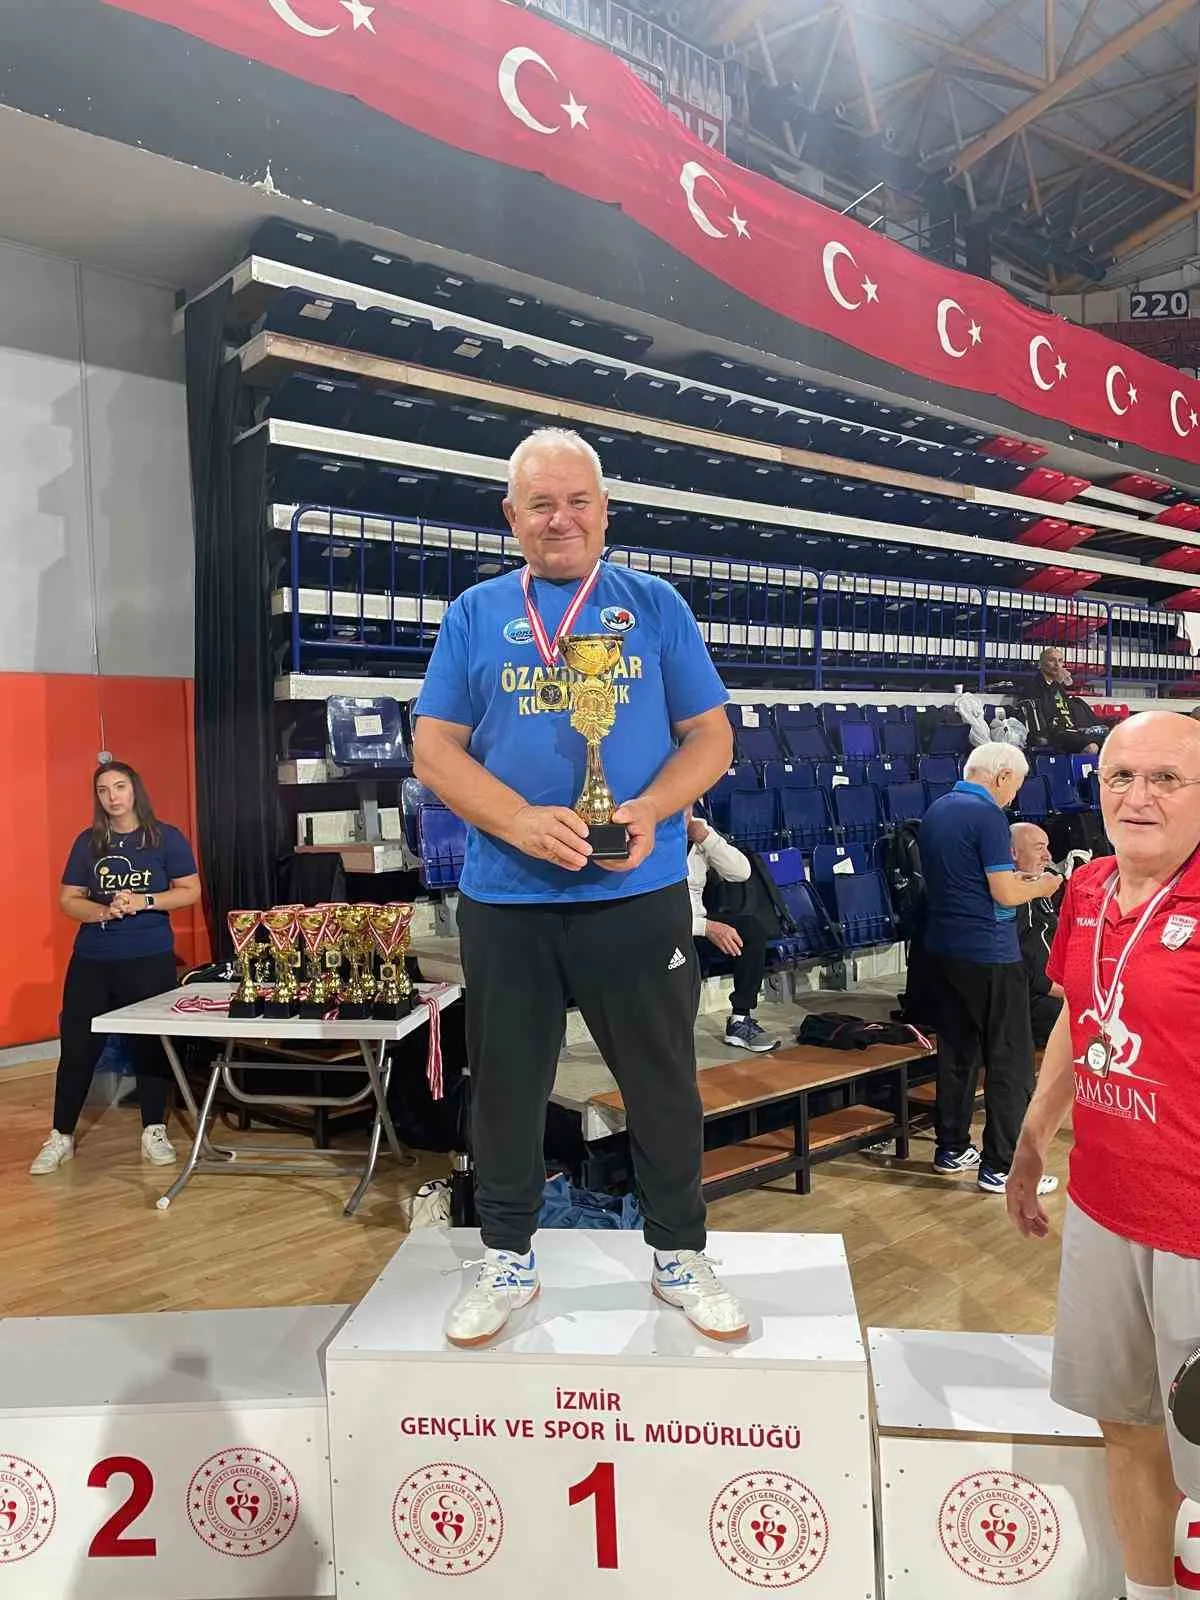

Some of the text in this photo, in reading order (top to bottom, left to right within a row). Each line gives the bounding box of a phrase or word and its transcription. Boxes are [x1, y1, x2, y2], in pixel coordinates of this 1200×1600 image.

[1131, 292, 1188, 317] 220
[99, 866, 152, 889] izvet
[1073, 1071, 1156, 1124] SAMSUN
[556, 1386, 621, 1411] İZMİR
[400, 1414, 801, 1449] GENÇLİK VE SPOR İL MÜDÜRLÜĞÜ
[87, 1456, 157, 1558] 2
[757, 1491, 793, 1504] GENÇLİK
[568, 1462, 619, 1569] 1
